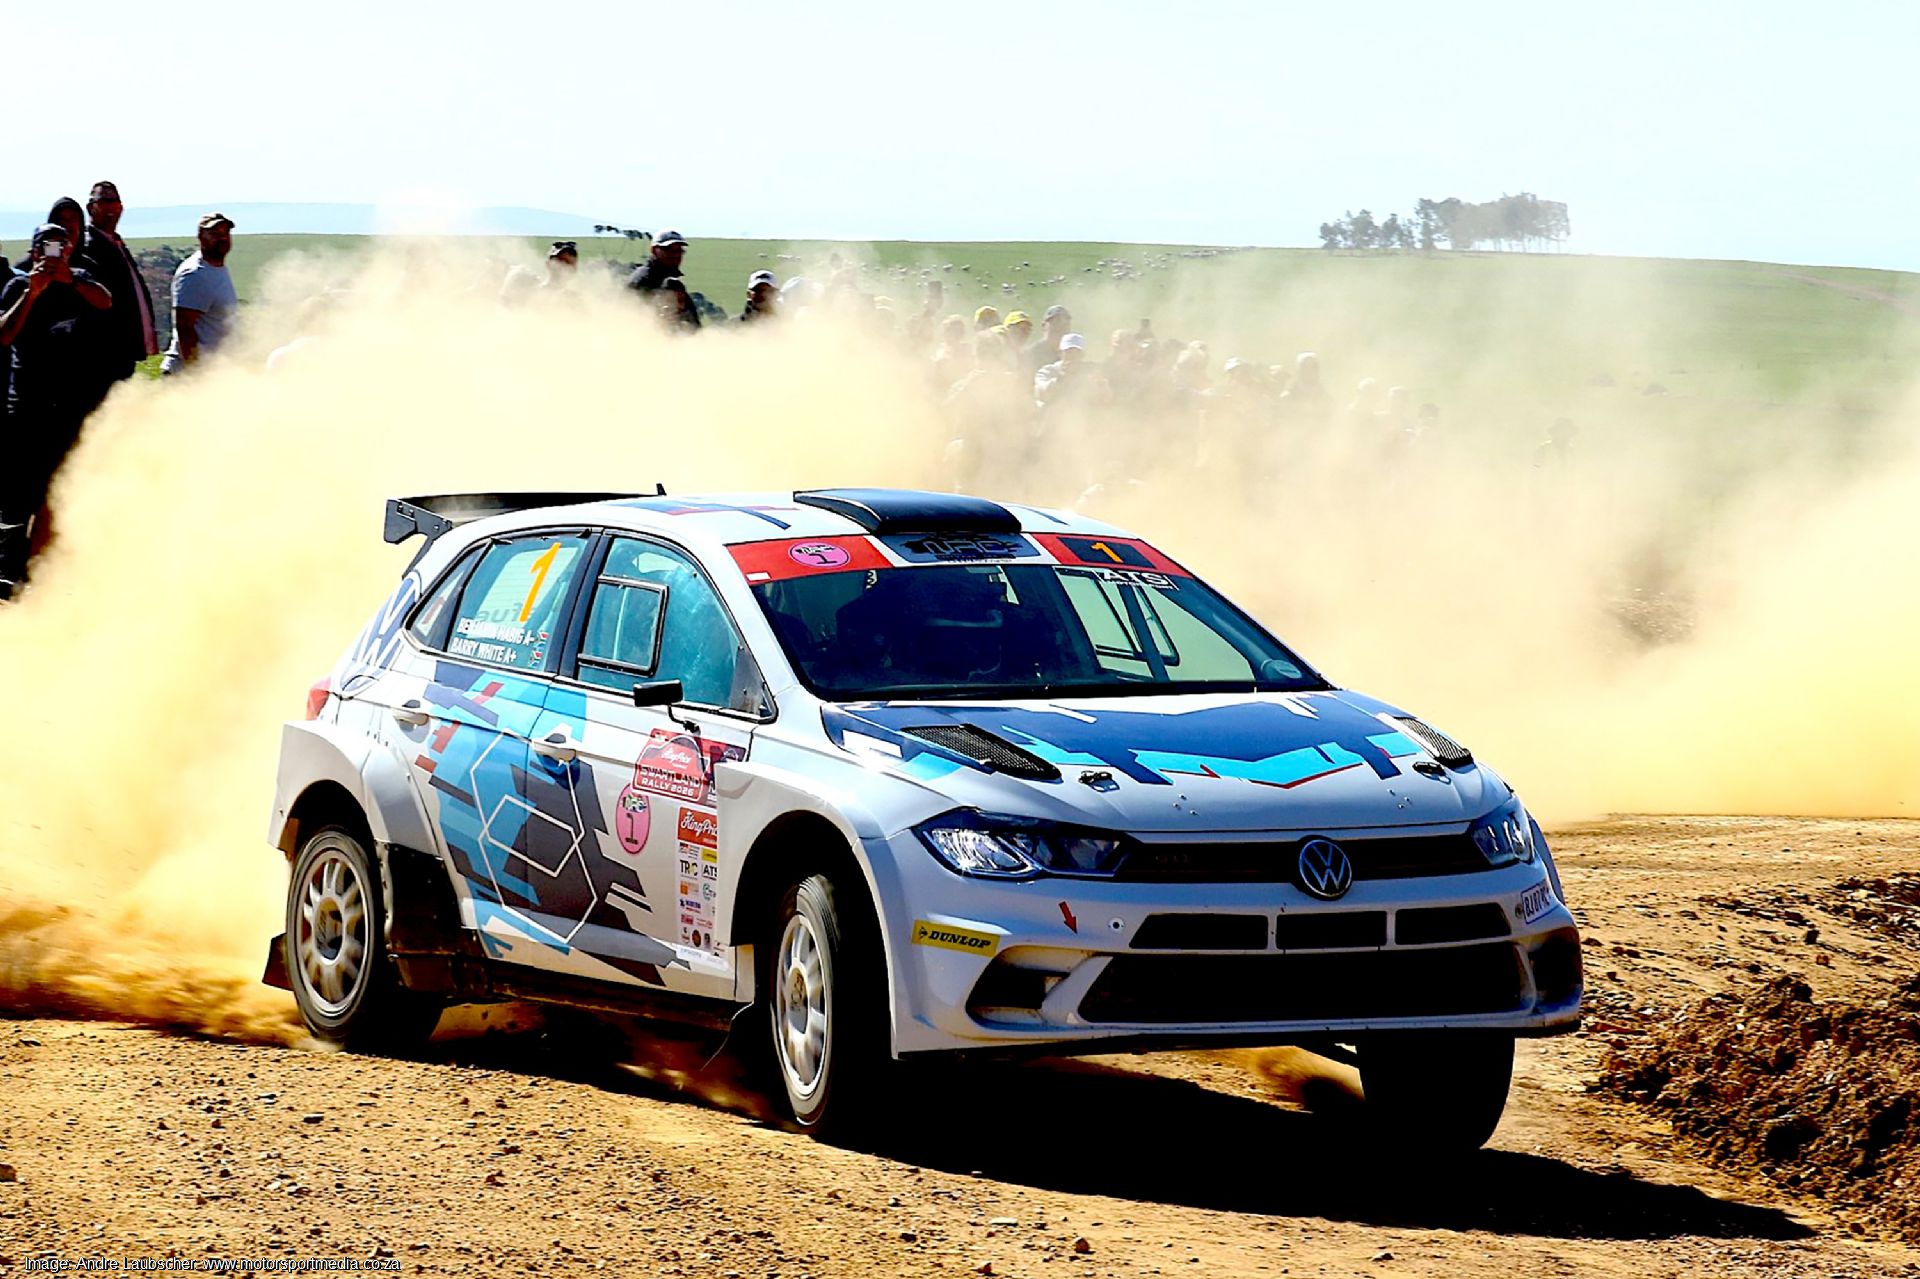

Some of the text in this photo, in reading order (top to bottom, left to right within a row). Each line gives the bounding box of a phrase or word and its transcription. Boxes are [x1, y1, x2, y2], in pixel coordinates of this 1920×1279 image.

[808, 553, 837, 565] 1
[1091, 542, 1124, 564] 1
[519, 542, 561, 623] 1
[1103, 569, 1169, 586] ATS
[641, 778, 670, 792] RALLY
[670, 784, 694, 797] 2026
[625, 812, 639, 845] 1
[1301, 842, 1347, 891] VW
[928, 930, 992, 949] DUNLOP
